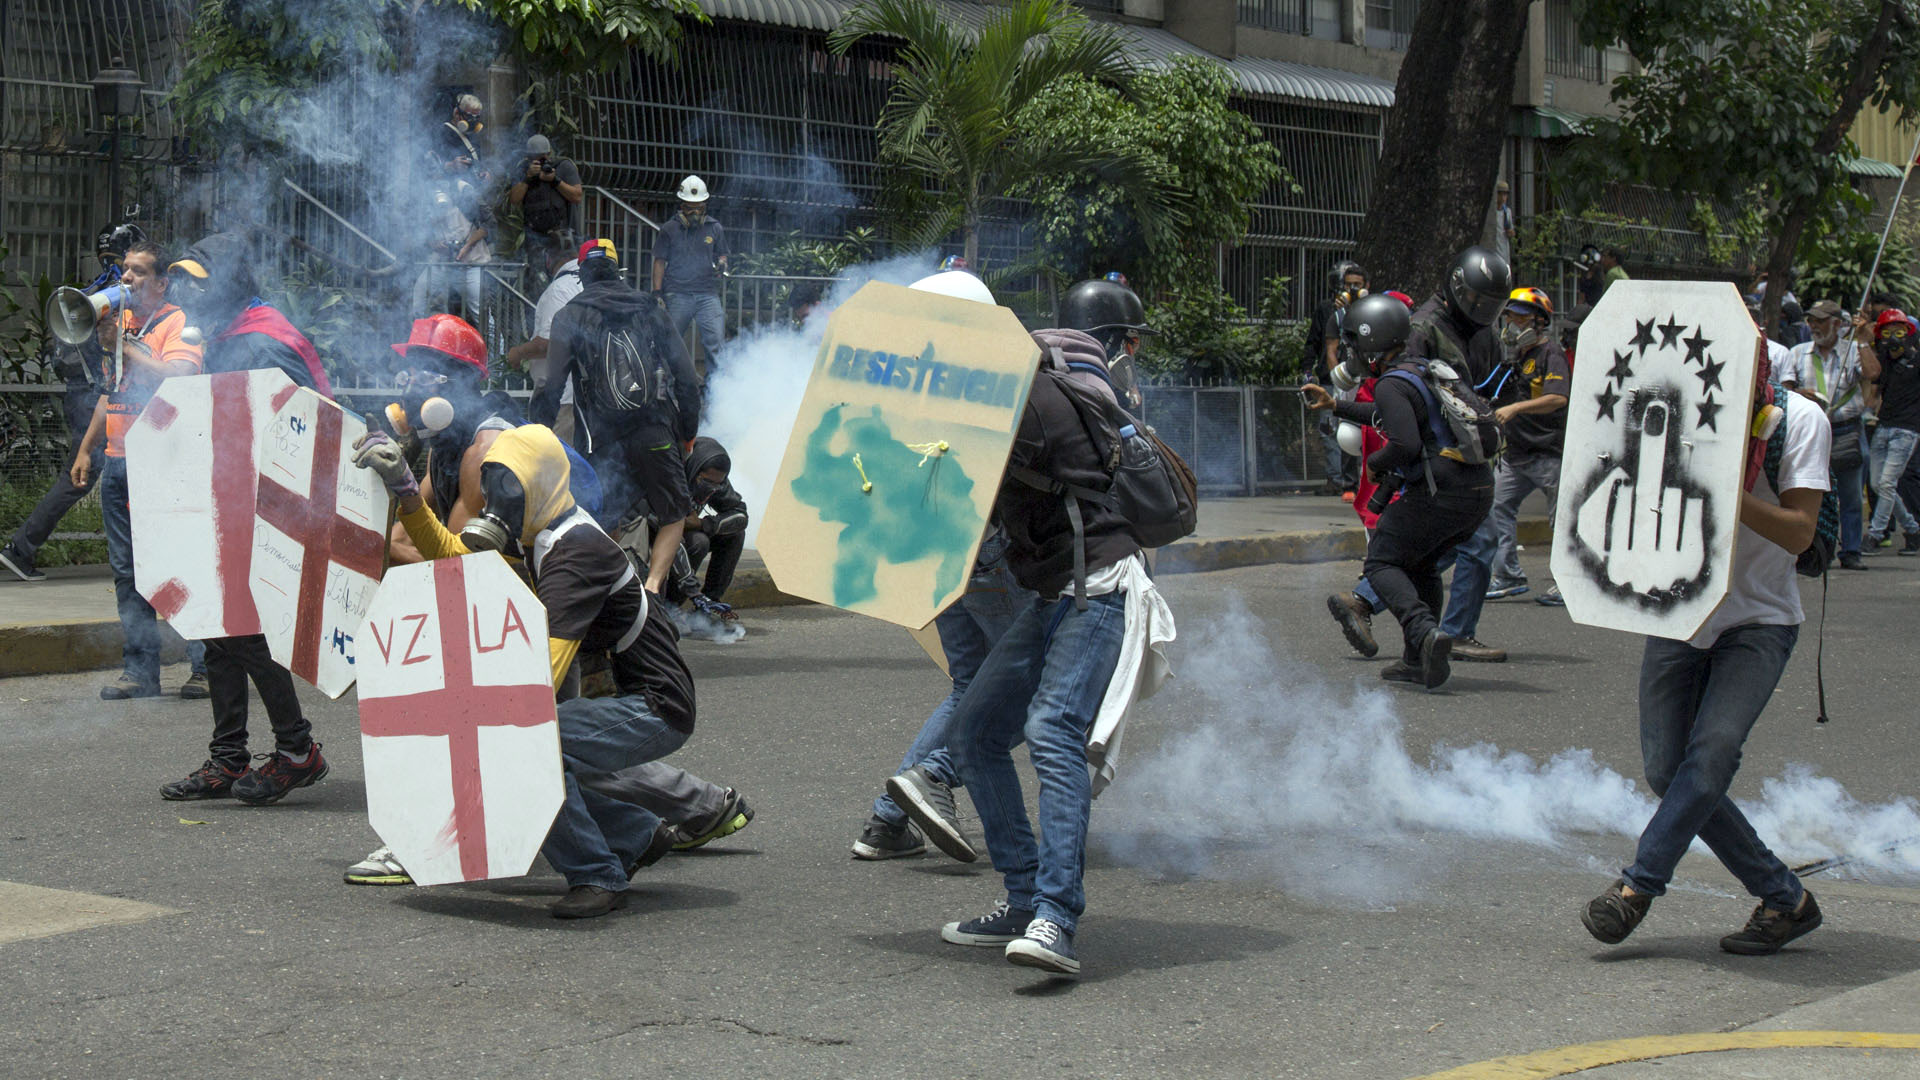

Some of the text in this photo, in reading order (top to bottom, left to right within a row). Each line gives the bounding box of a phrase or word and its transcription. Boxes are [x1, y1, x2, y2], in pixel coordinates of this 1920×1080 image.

[829, 342, 1019, 408] RESISTENCIA
[370, 597, 533, 666] VZ LA
